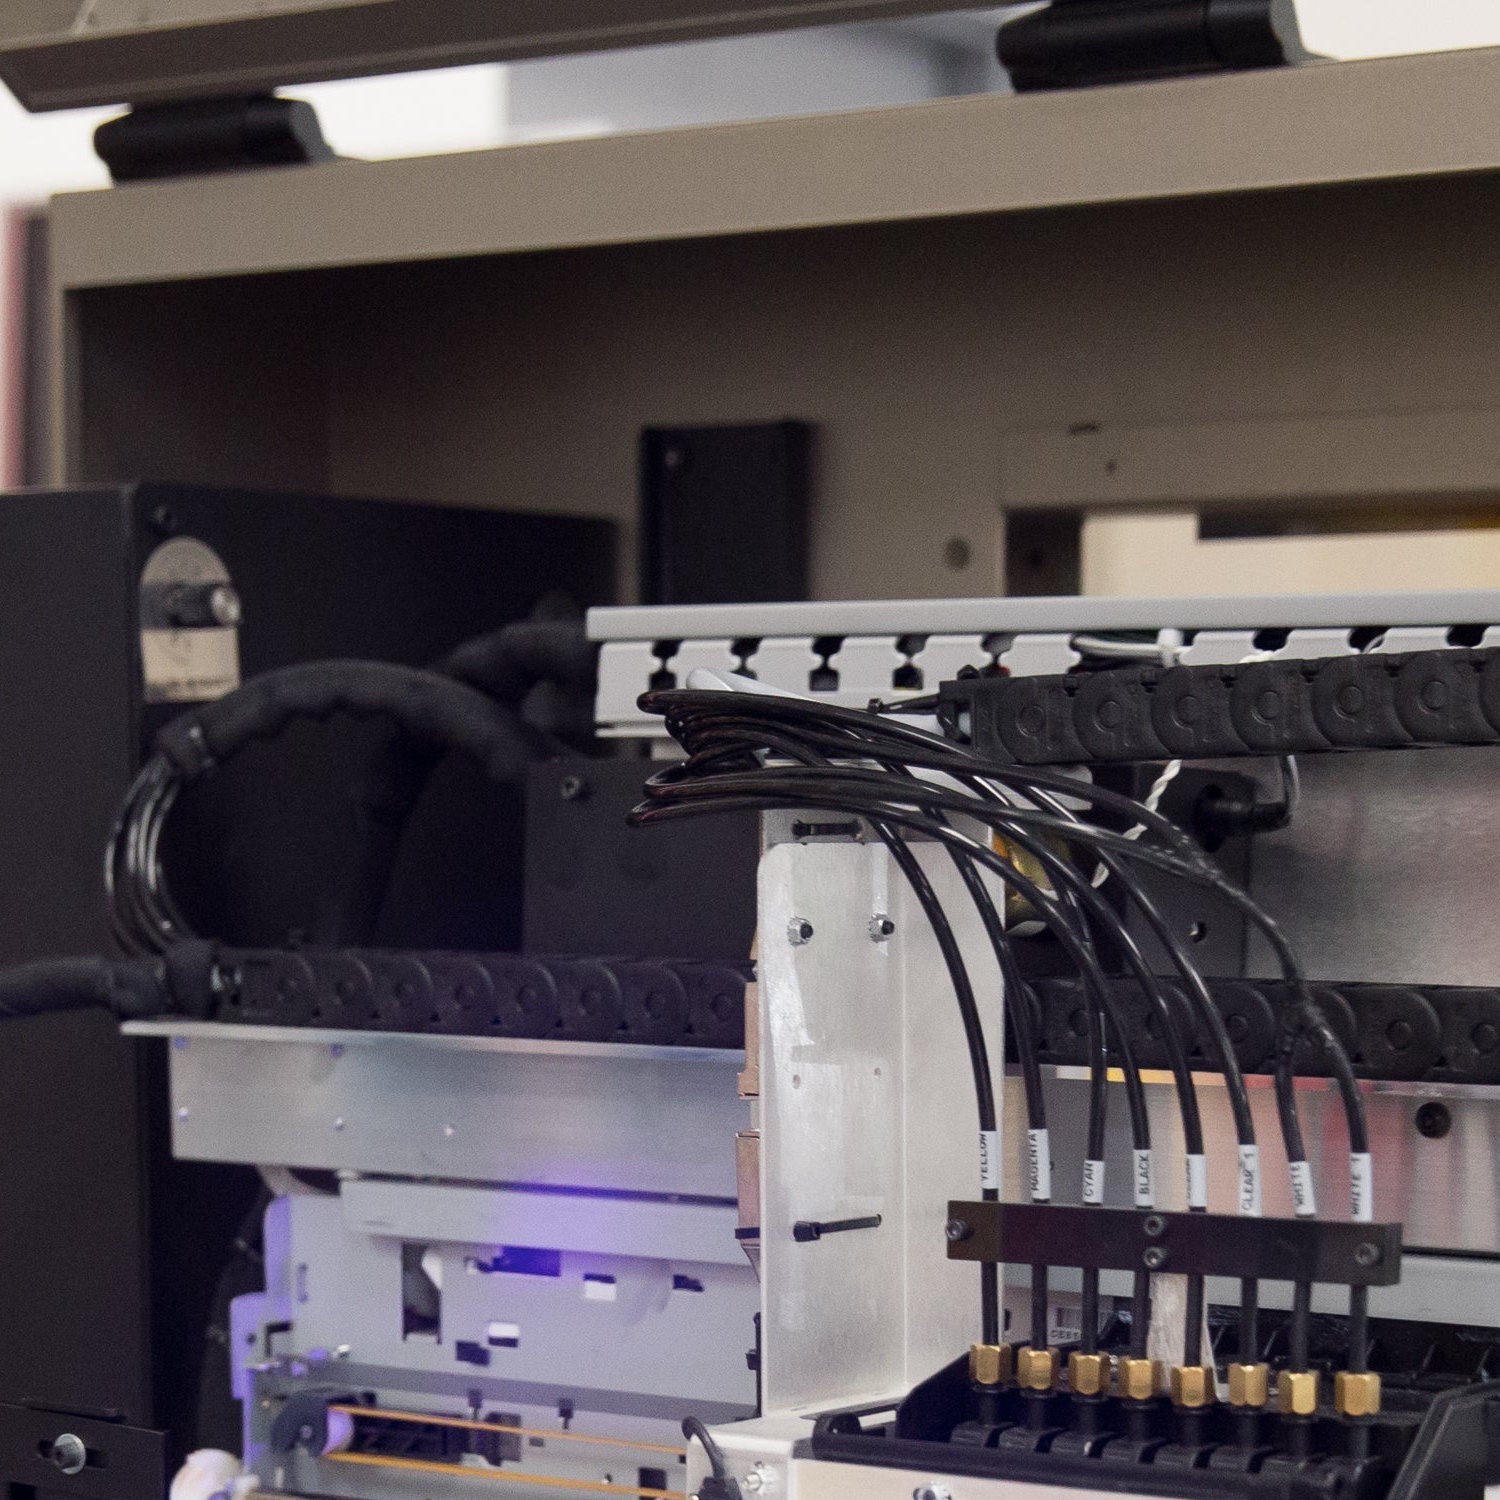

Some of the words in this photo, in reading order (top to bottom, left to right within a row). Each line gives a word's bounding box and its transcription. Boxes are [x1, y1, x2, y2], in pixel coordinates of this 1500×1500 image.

[979, 1133, 988, 1181] YELLOW
[1029, 1133, 1040, 1191] MAGENTA
[1138, 1154, 1150, 1195] BLACK
[1084, 1162, 1094, 1197] CYAN
[1241, 1169, 1255, 1211] CLEAR
[1290, 1165, 1304, 1206] WHITE
[1352, 1174, 1361, 1215] WHITE
